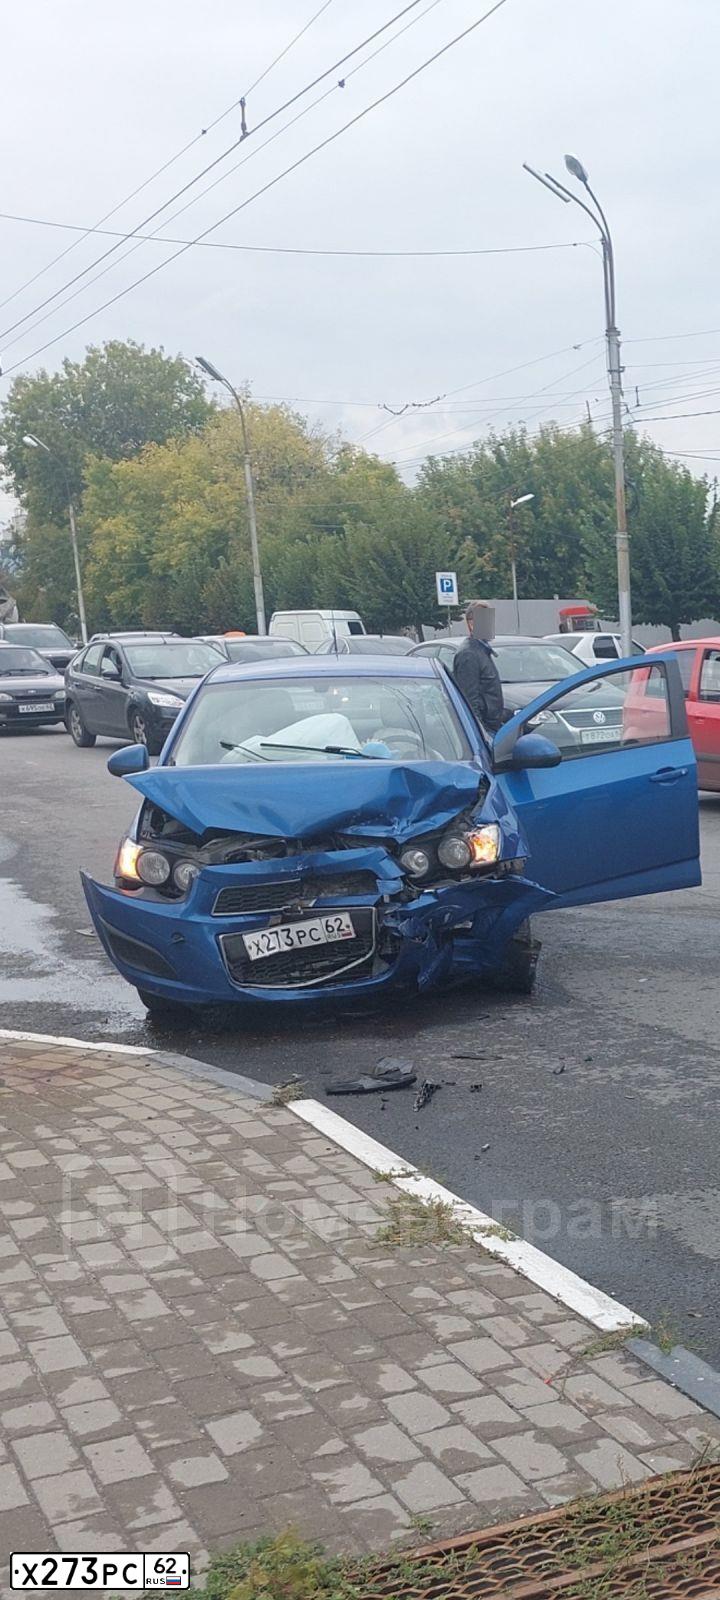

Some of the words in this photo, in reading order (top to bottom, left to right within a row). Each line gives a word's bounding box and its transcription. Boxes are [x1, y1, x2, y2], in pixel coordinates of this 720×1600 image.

[443, 579, 452, 592] P
[252, 928, 321, 955] Х273РС
[325, 917, 345, 933] 62
